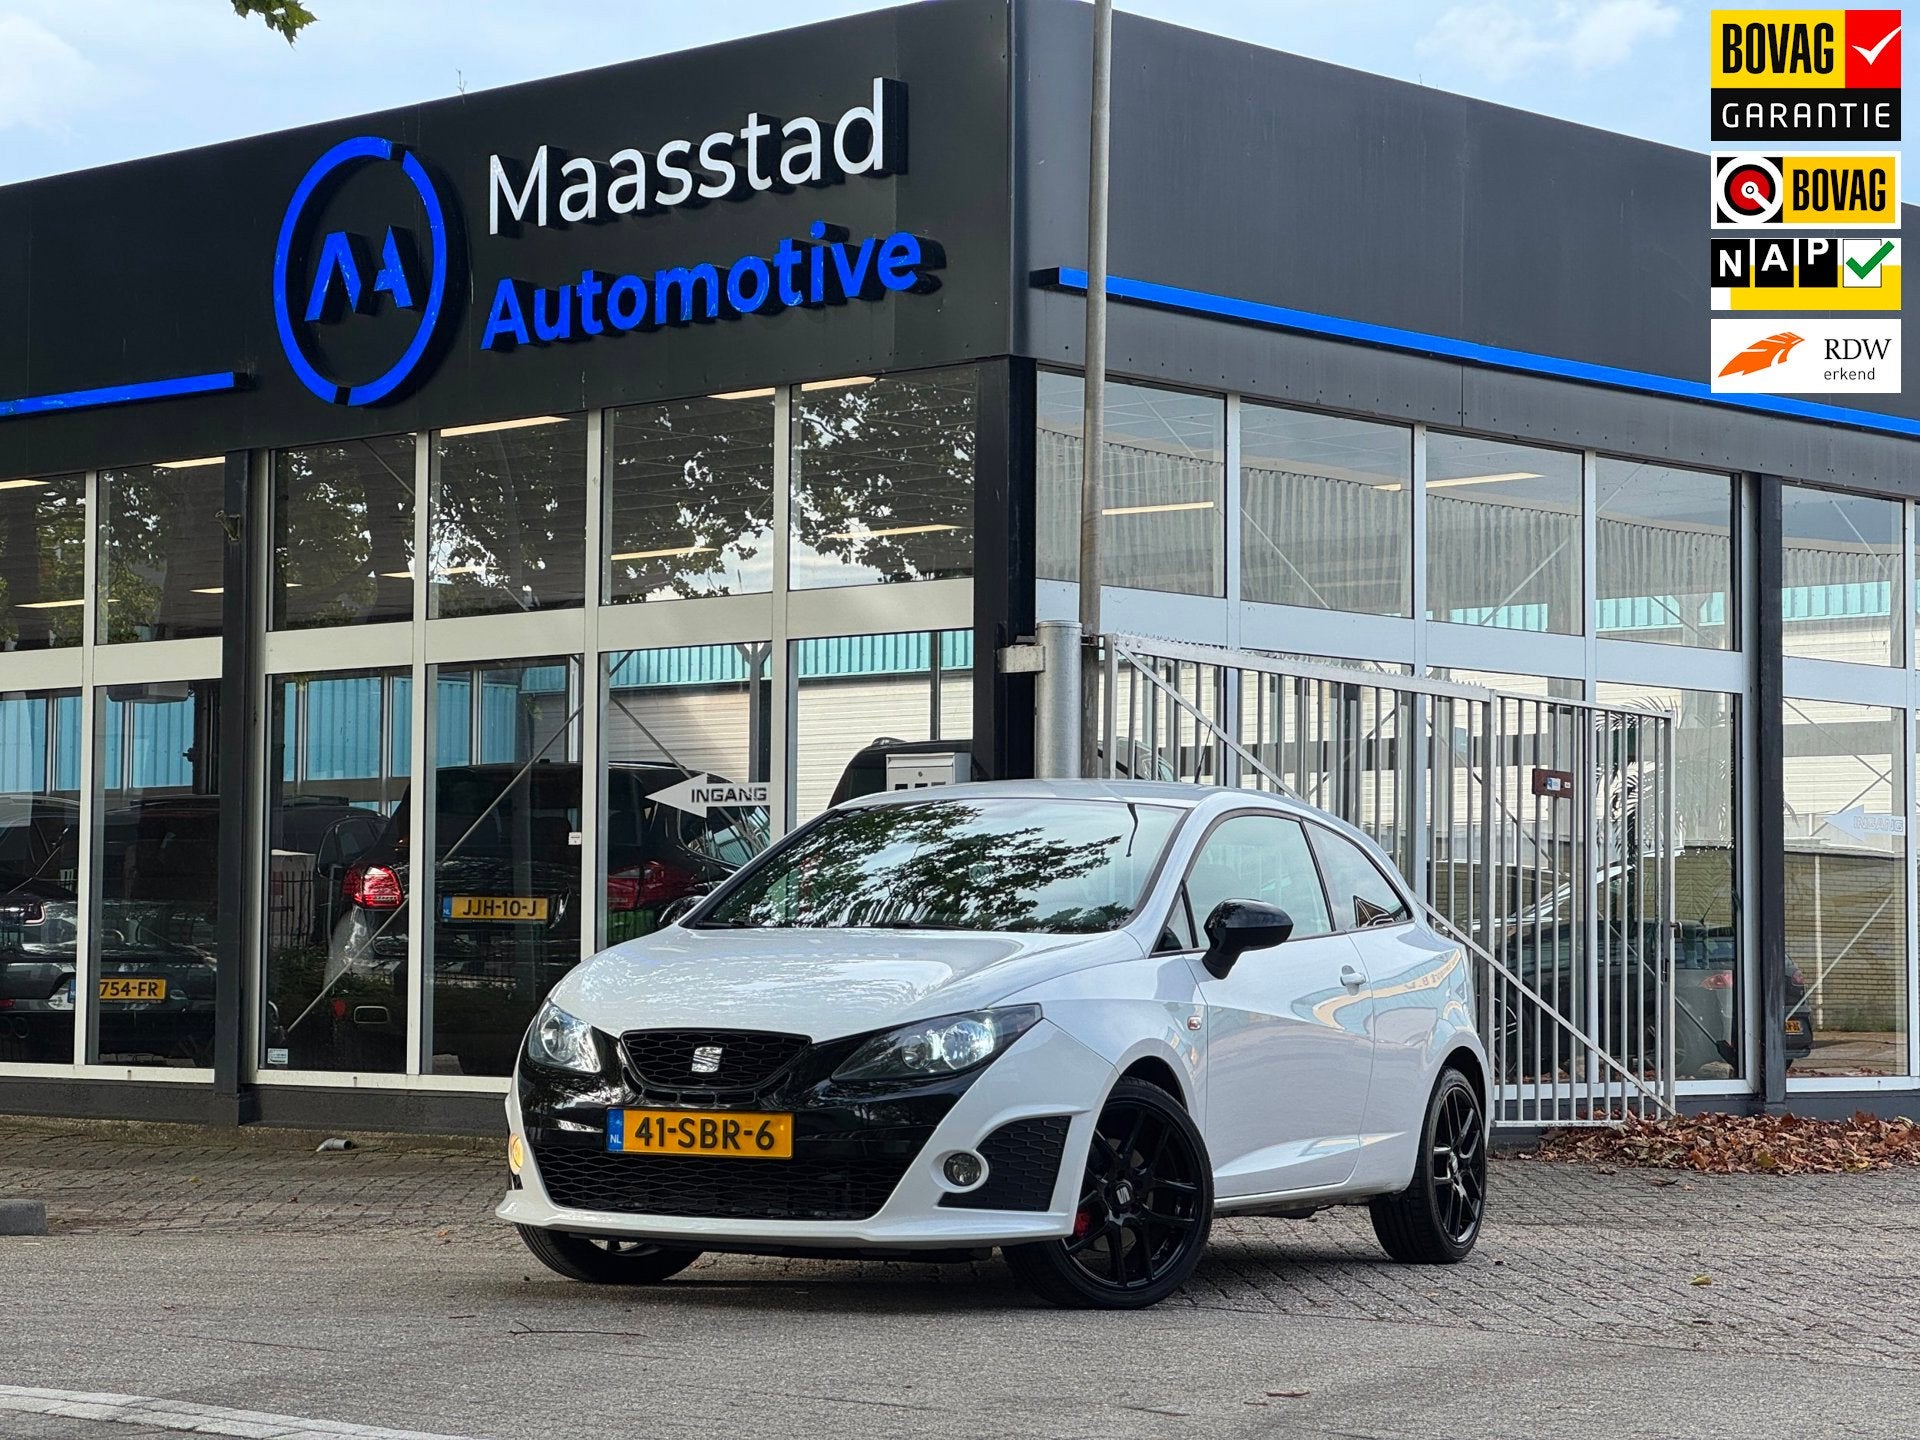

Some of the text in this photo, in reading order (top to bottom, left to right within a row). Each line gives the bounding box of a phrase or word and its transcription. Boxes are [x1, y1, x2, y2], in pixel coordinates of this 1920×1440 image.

[489, 77, 883, 235] Maasstad
[480, 220, 921, 350] Automotive
[690, 787, 767, 803] INGANG
[1853, 816, 1904, 832] INGANG
[463, 899, 537, 917] JJH-10-J
[100, 981, 158, 997] 754-FR
[609, 1116, 775, 1150] NL 41-SBR-6
